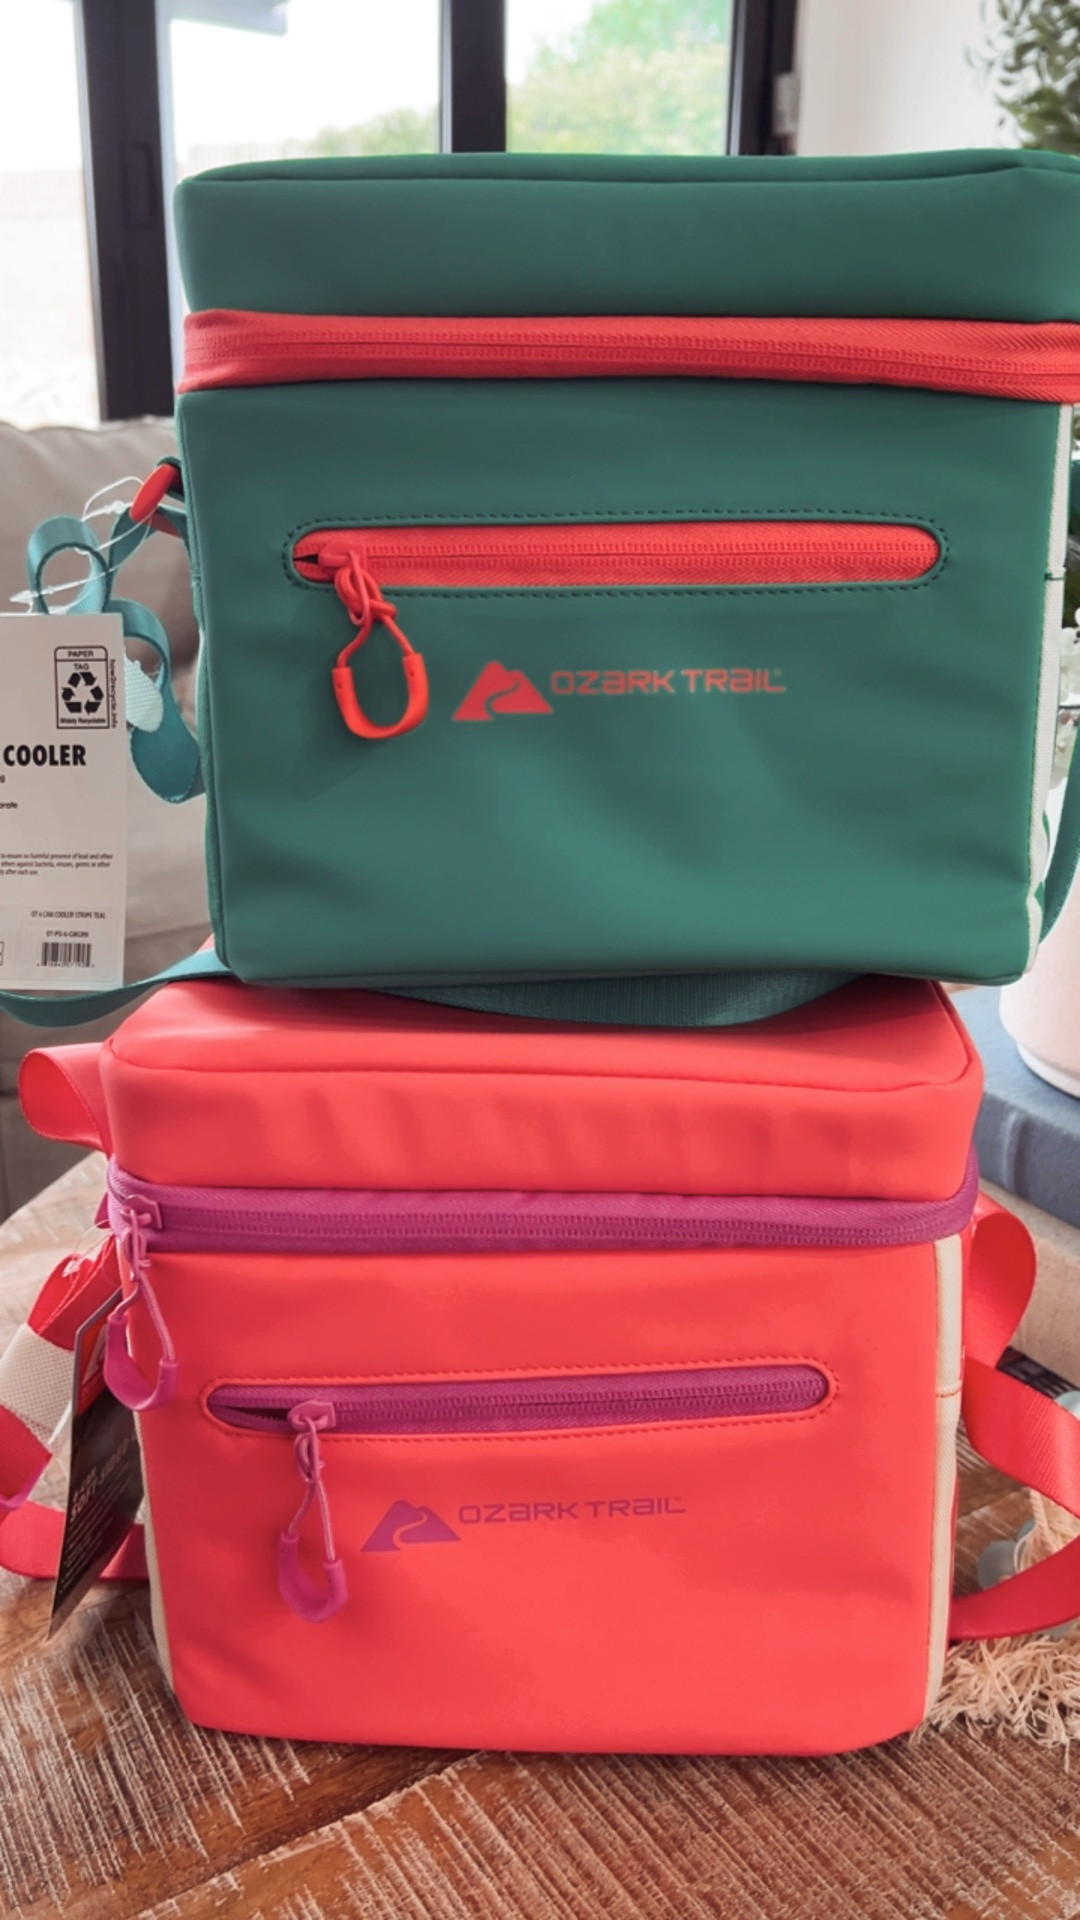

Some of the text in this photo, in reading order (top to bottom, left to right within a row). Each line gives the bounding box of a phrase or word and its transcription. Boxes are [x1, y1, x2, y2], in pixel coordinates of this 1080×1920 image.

[551, 667, 785, 695] OZARK TRAIL
[3, 745, 87, 766] COOLER
[54, 911, 74, 919] COOLER
[75, 911, 92, 919] STRIPE
[459, 1496, 686, 1525] OZARK TRAIL
